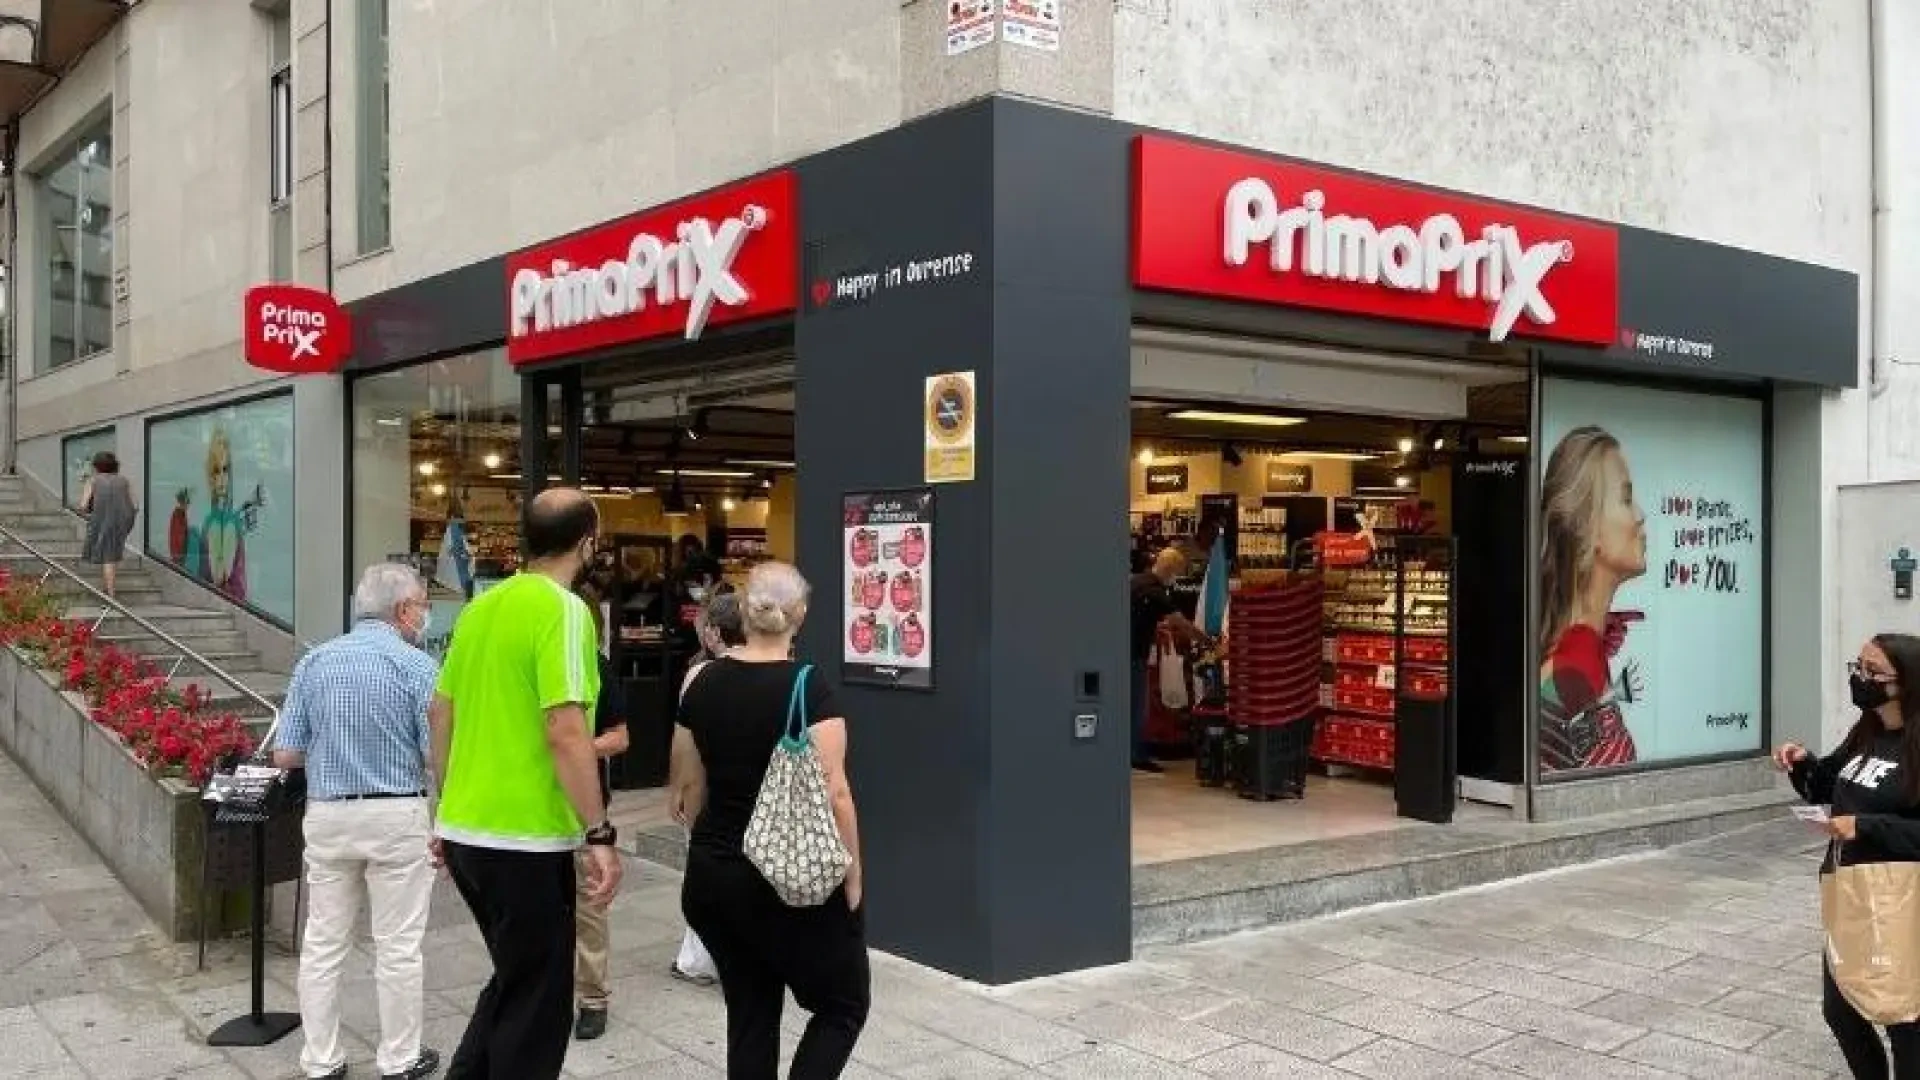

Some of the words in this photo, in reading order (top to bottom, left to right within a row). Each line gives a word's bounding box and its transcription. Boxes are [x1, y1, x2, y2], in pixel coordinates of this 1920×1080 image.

[836, 272, 878, 299] Happy
[885, 264, 901, 289] in
[906, 252, 973, 283] Ourense
[261, 302, 326, 327] Prima
